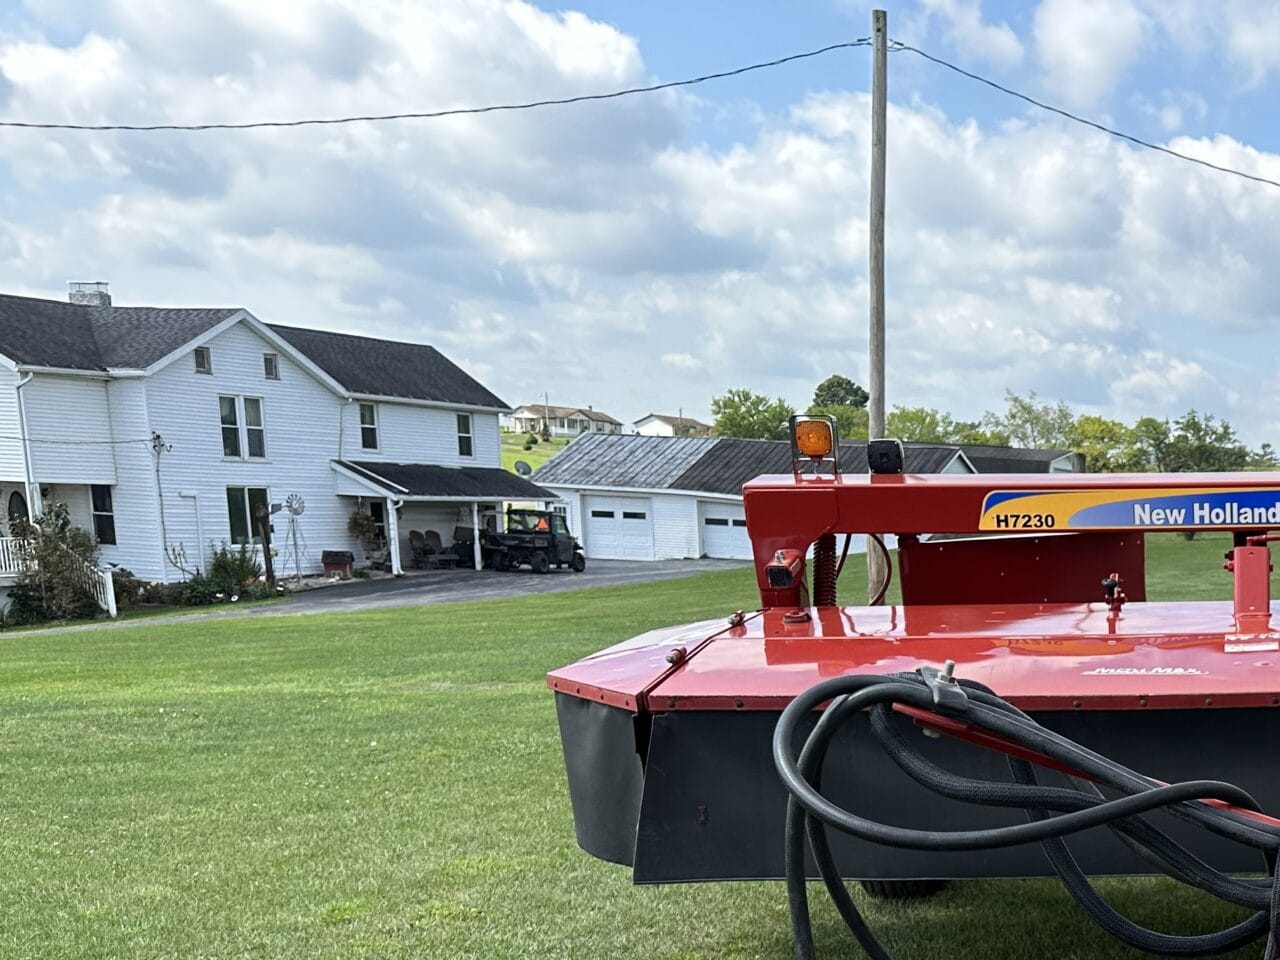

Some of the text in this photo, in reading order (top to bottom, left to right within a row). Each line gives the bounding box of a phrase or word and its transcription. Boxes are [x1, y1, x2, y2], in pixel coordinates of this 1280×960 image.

[996, 514, 1055, 528] H7230
[1134, 502, 1280, 525] New Holland
